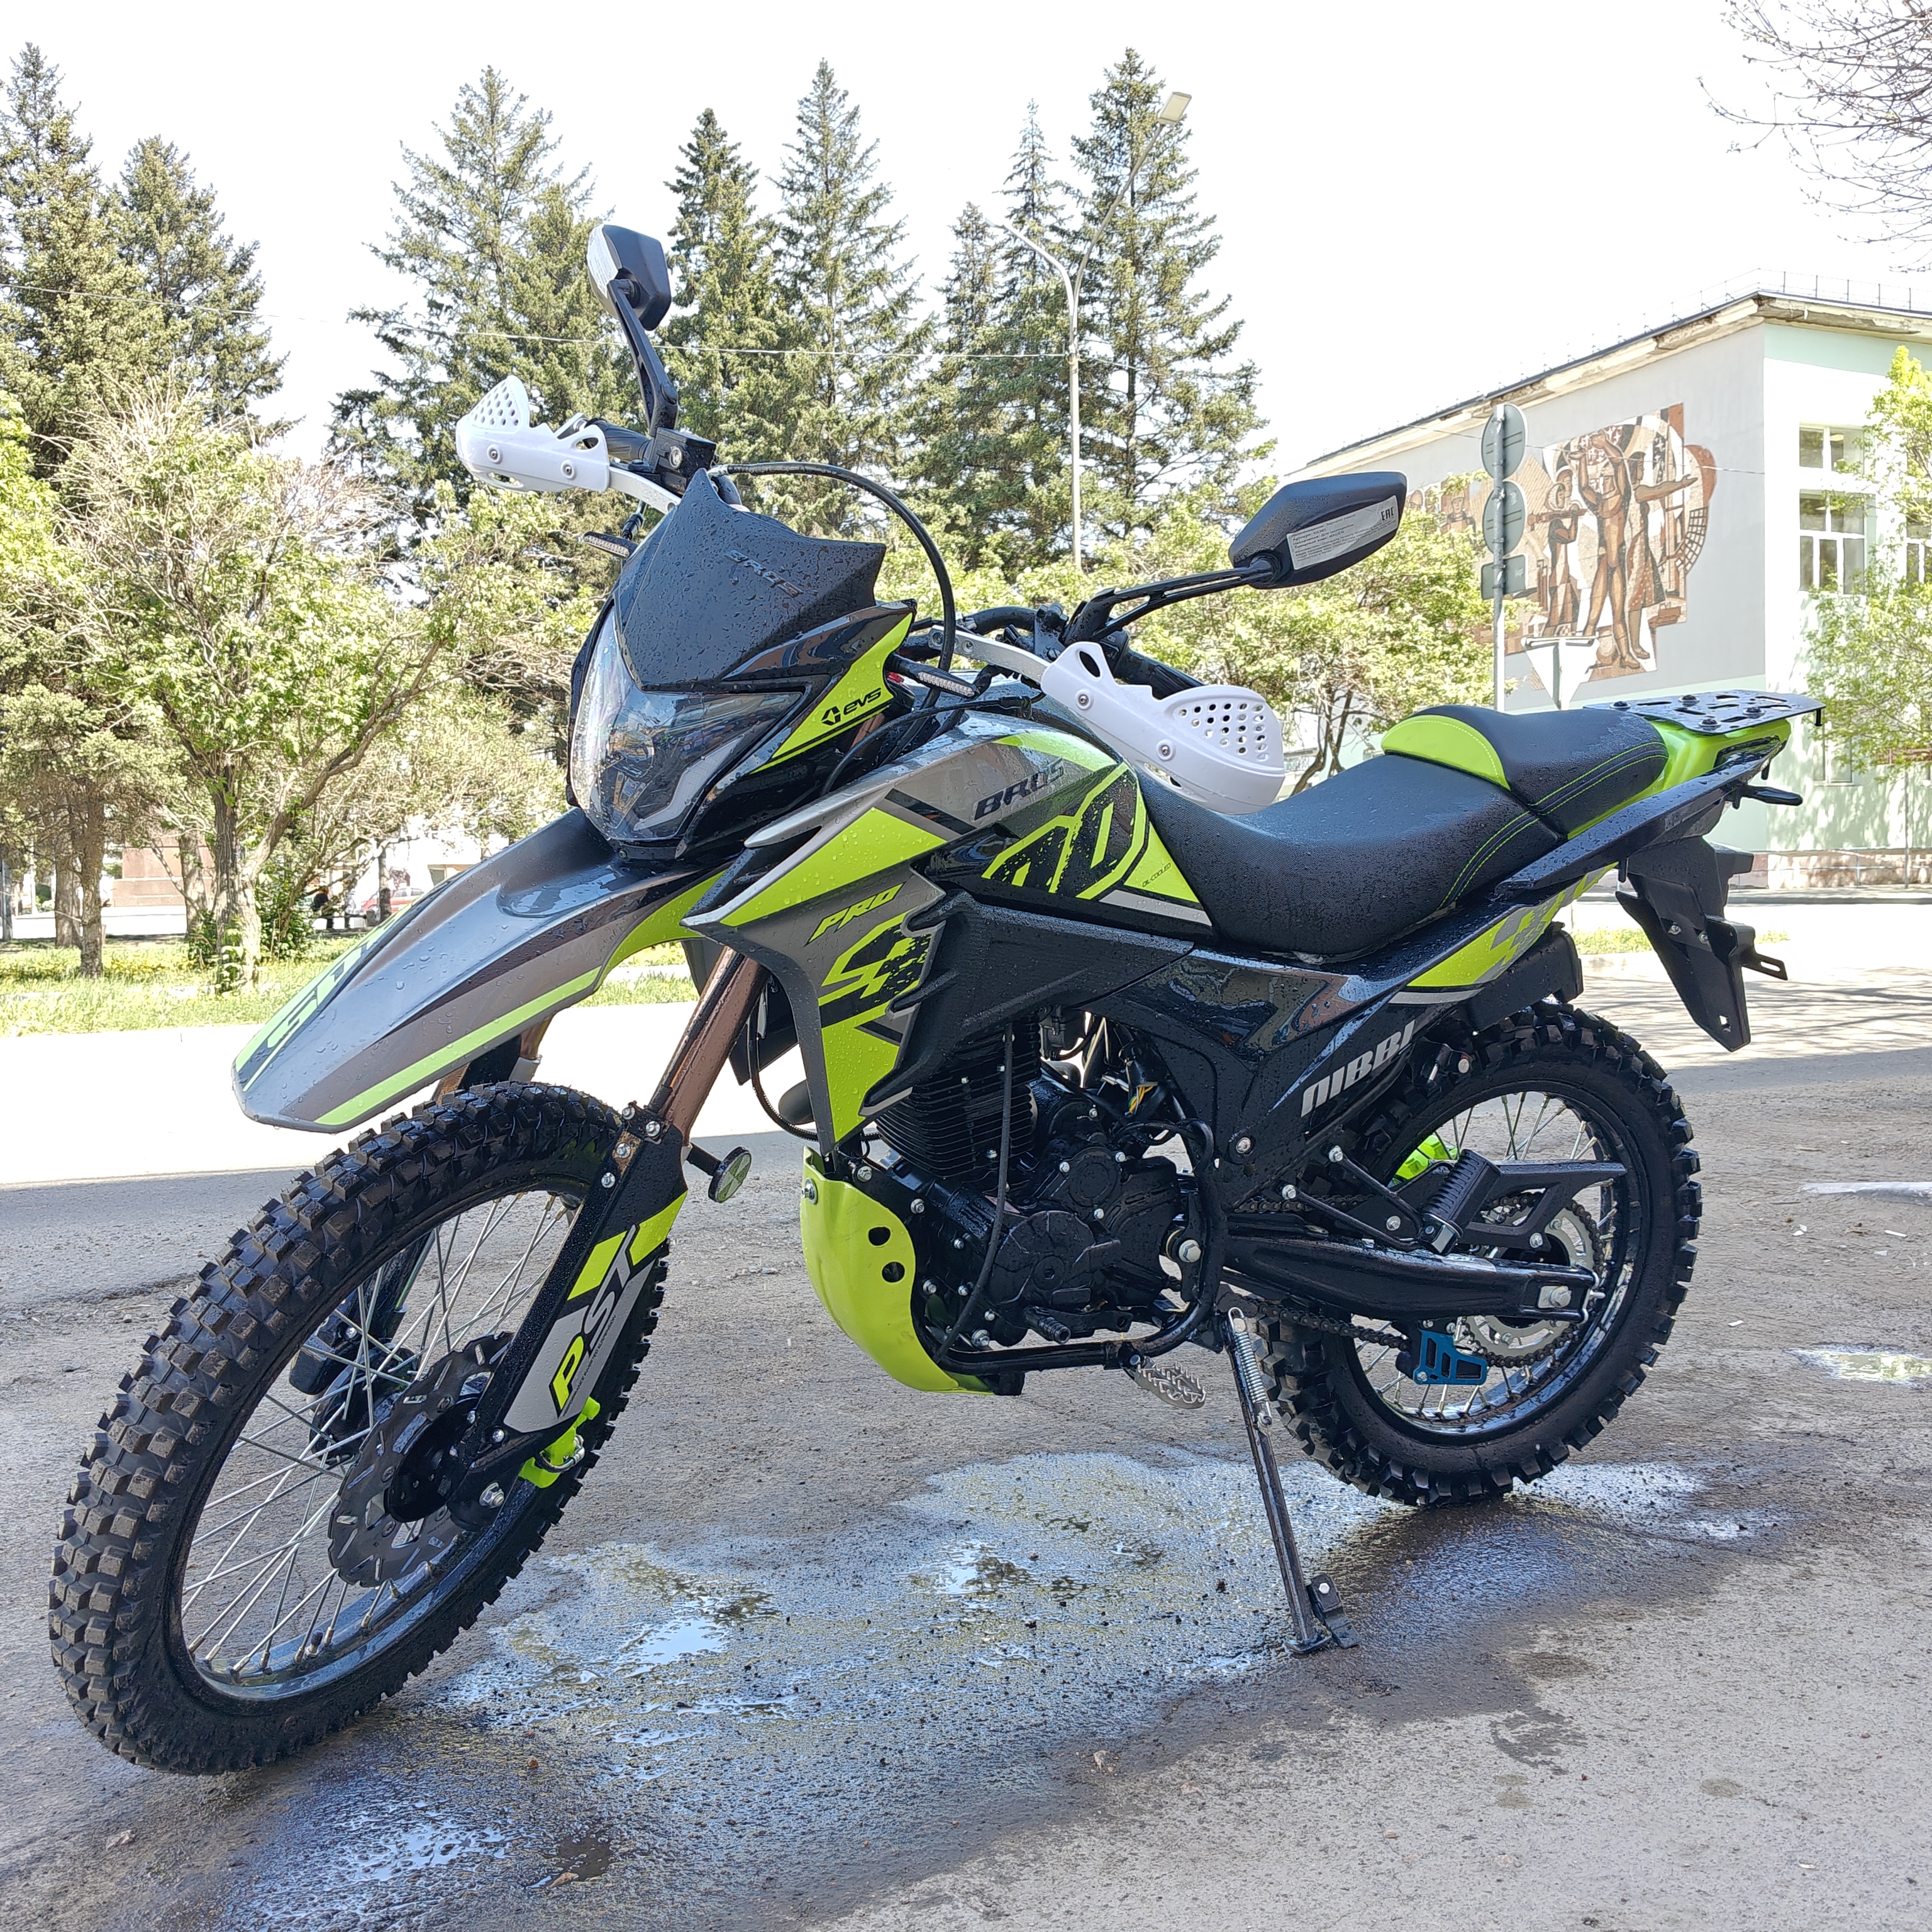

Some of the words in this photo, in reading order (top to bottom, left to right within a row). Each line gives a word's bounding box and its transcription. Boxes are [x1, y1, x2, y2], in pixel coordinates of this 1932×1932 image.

[1380, 506, 1394, 521] EAC
[1142, 862, 1171, 887] OIL-COOLED
[804, 882, 906, 947] PRO
[552, 1224, 636, 1413] PST
